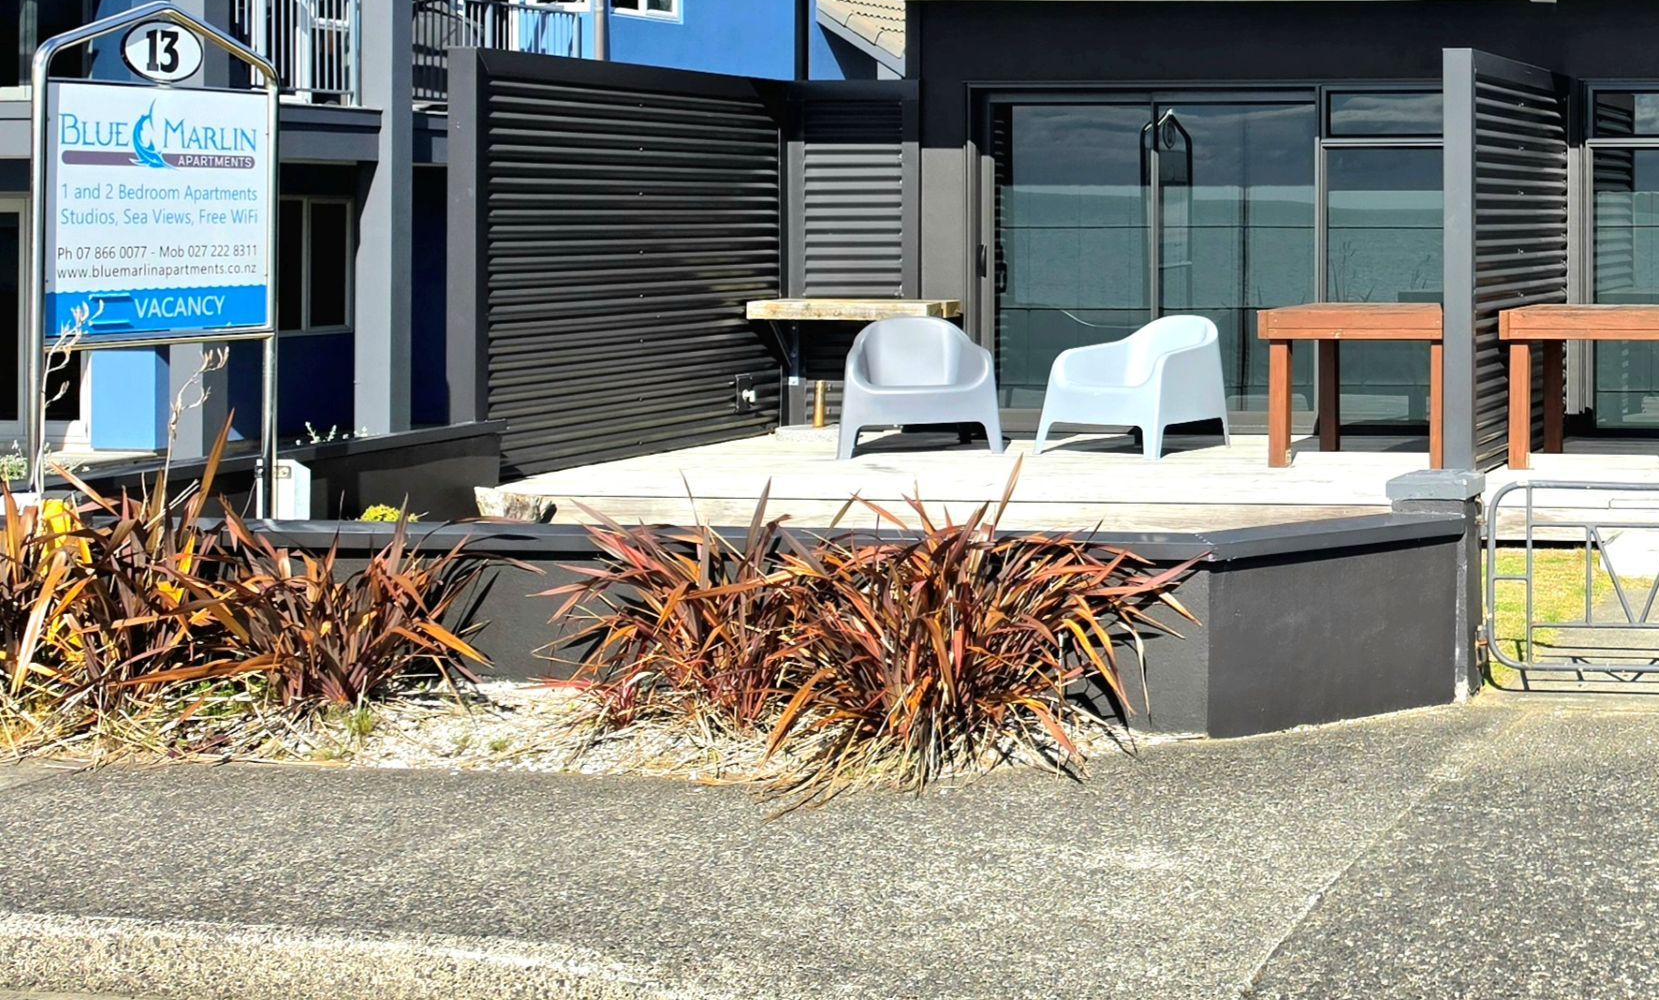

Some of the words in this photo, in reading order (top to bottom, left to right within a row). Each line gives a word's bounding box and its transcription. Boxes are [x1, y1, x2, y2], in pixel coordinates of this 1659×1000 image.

[147, 30, 179, 73] 13
[60, 114, 129, 147] BLUE
[164, 118, 256, 151] MARLIN
[178, 156, 252, 168] APARTMENTS
[61, 184, 67, 198] 1
[74, 184, 100, 199] and
[105, 185, 113, 199] 2
[119, 187, 179, 201] Bedroom
[184, 188, 258, 204] Apartments
[61, 209, 118, 226] Studios,
[124, 211, 147, 225] Sea
[152, 210, 194, 226] Views,
[199, 210, 227, 224] Free
[231, 210, 258, 223] WiFi
[58, 247, 73, 260] Ph
[77, 247, 90, 259] 07
[95, 246, 116, 259] 866
[120, 246, 147, 258] 0077
[160, 245, 185, 258] Mob
[188, 246, 207, 257] 027
[211, 245, 230, 256] 222
[234, 245, 257, 256] 8311
[57, 262, 256, 279] www.bluemarlinapartments.co.nz
[135, 295, 226, 318] VACANCY
